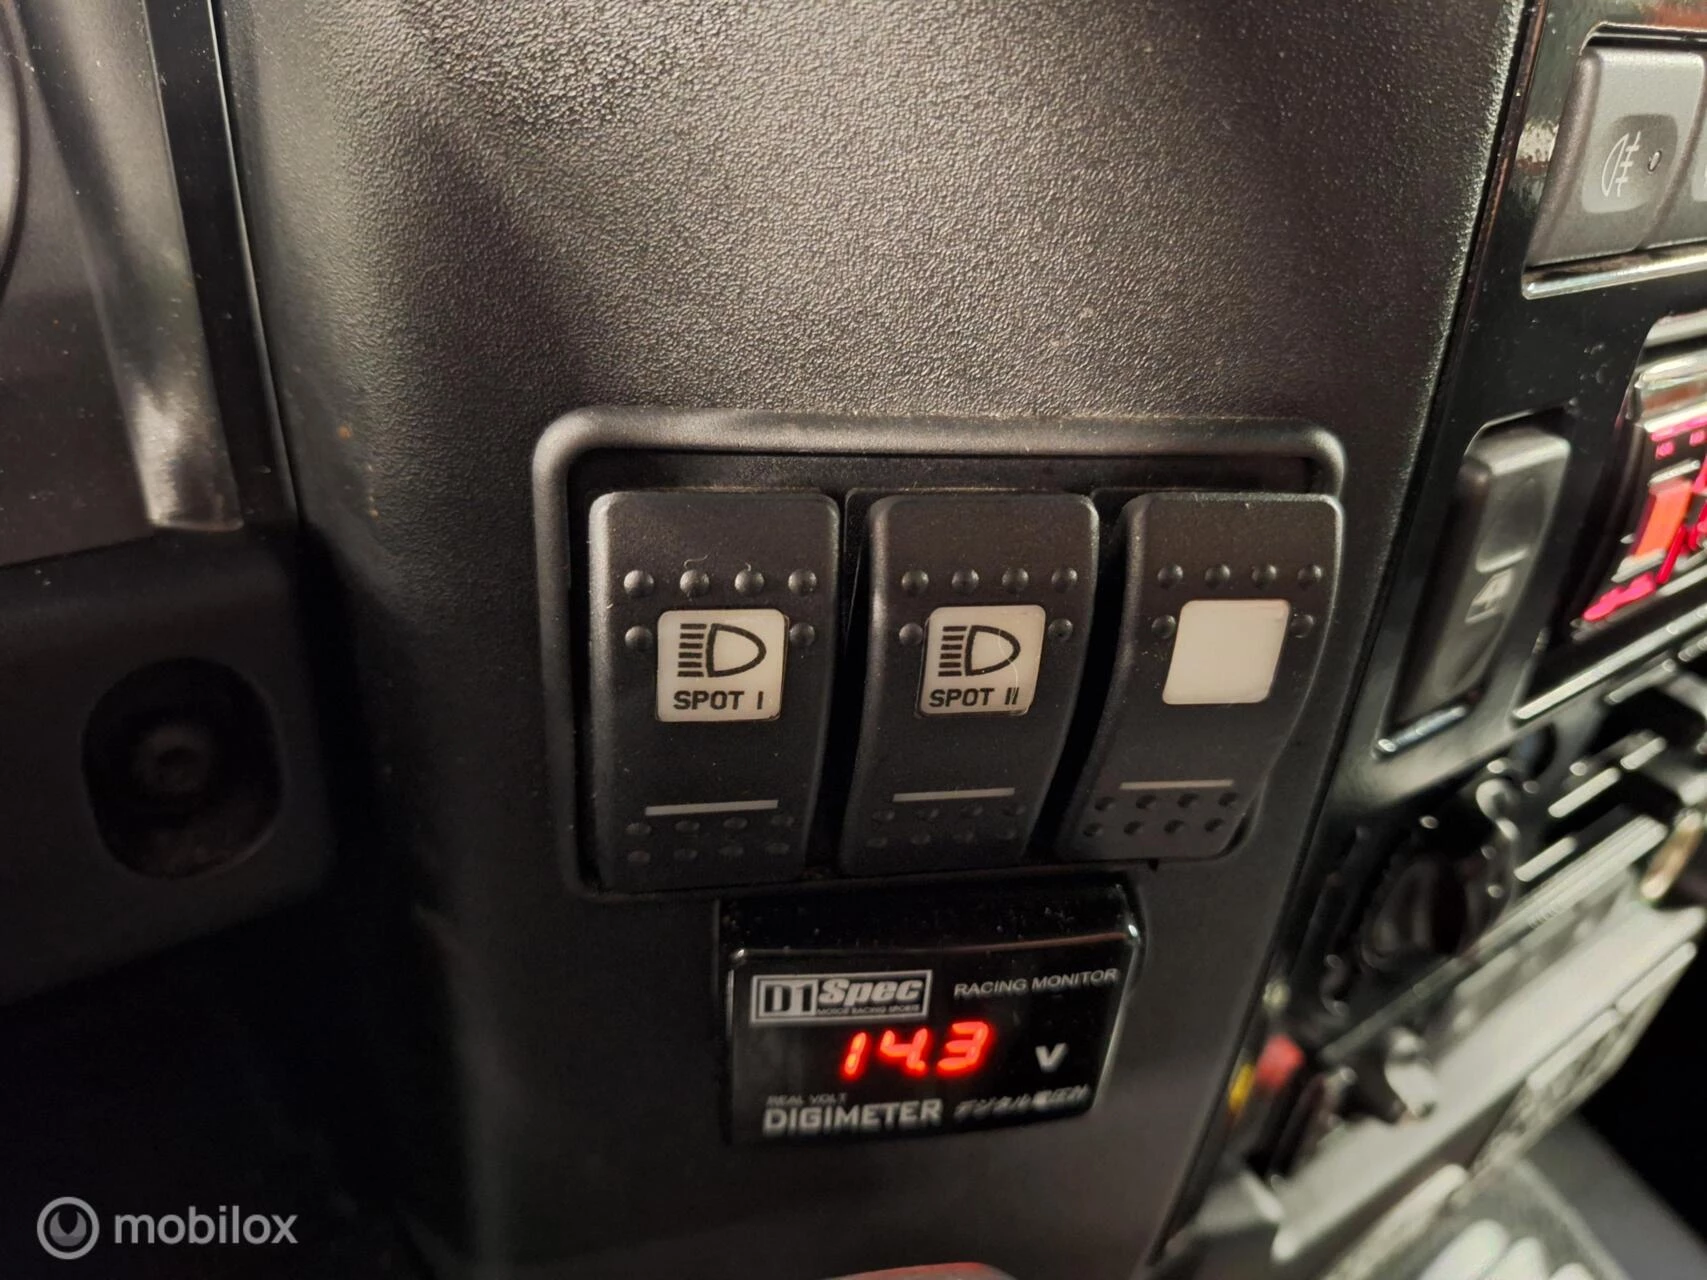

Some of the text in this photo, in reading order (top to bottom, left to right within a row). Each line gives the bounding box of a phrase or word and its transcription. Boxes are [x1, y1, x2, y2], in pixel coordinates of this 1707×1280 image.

[672, 690, 764, 710] SPOT I
[928, 687, 1020, 707] SPOT II
[953, 968, 1120, 998] RACING MONITOR
[842, 1020, 990, 1076] 14.3
[762, 1098, 944, 1136] DIGIMETER
